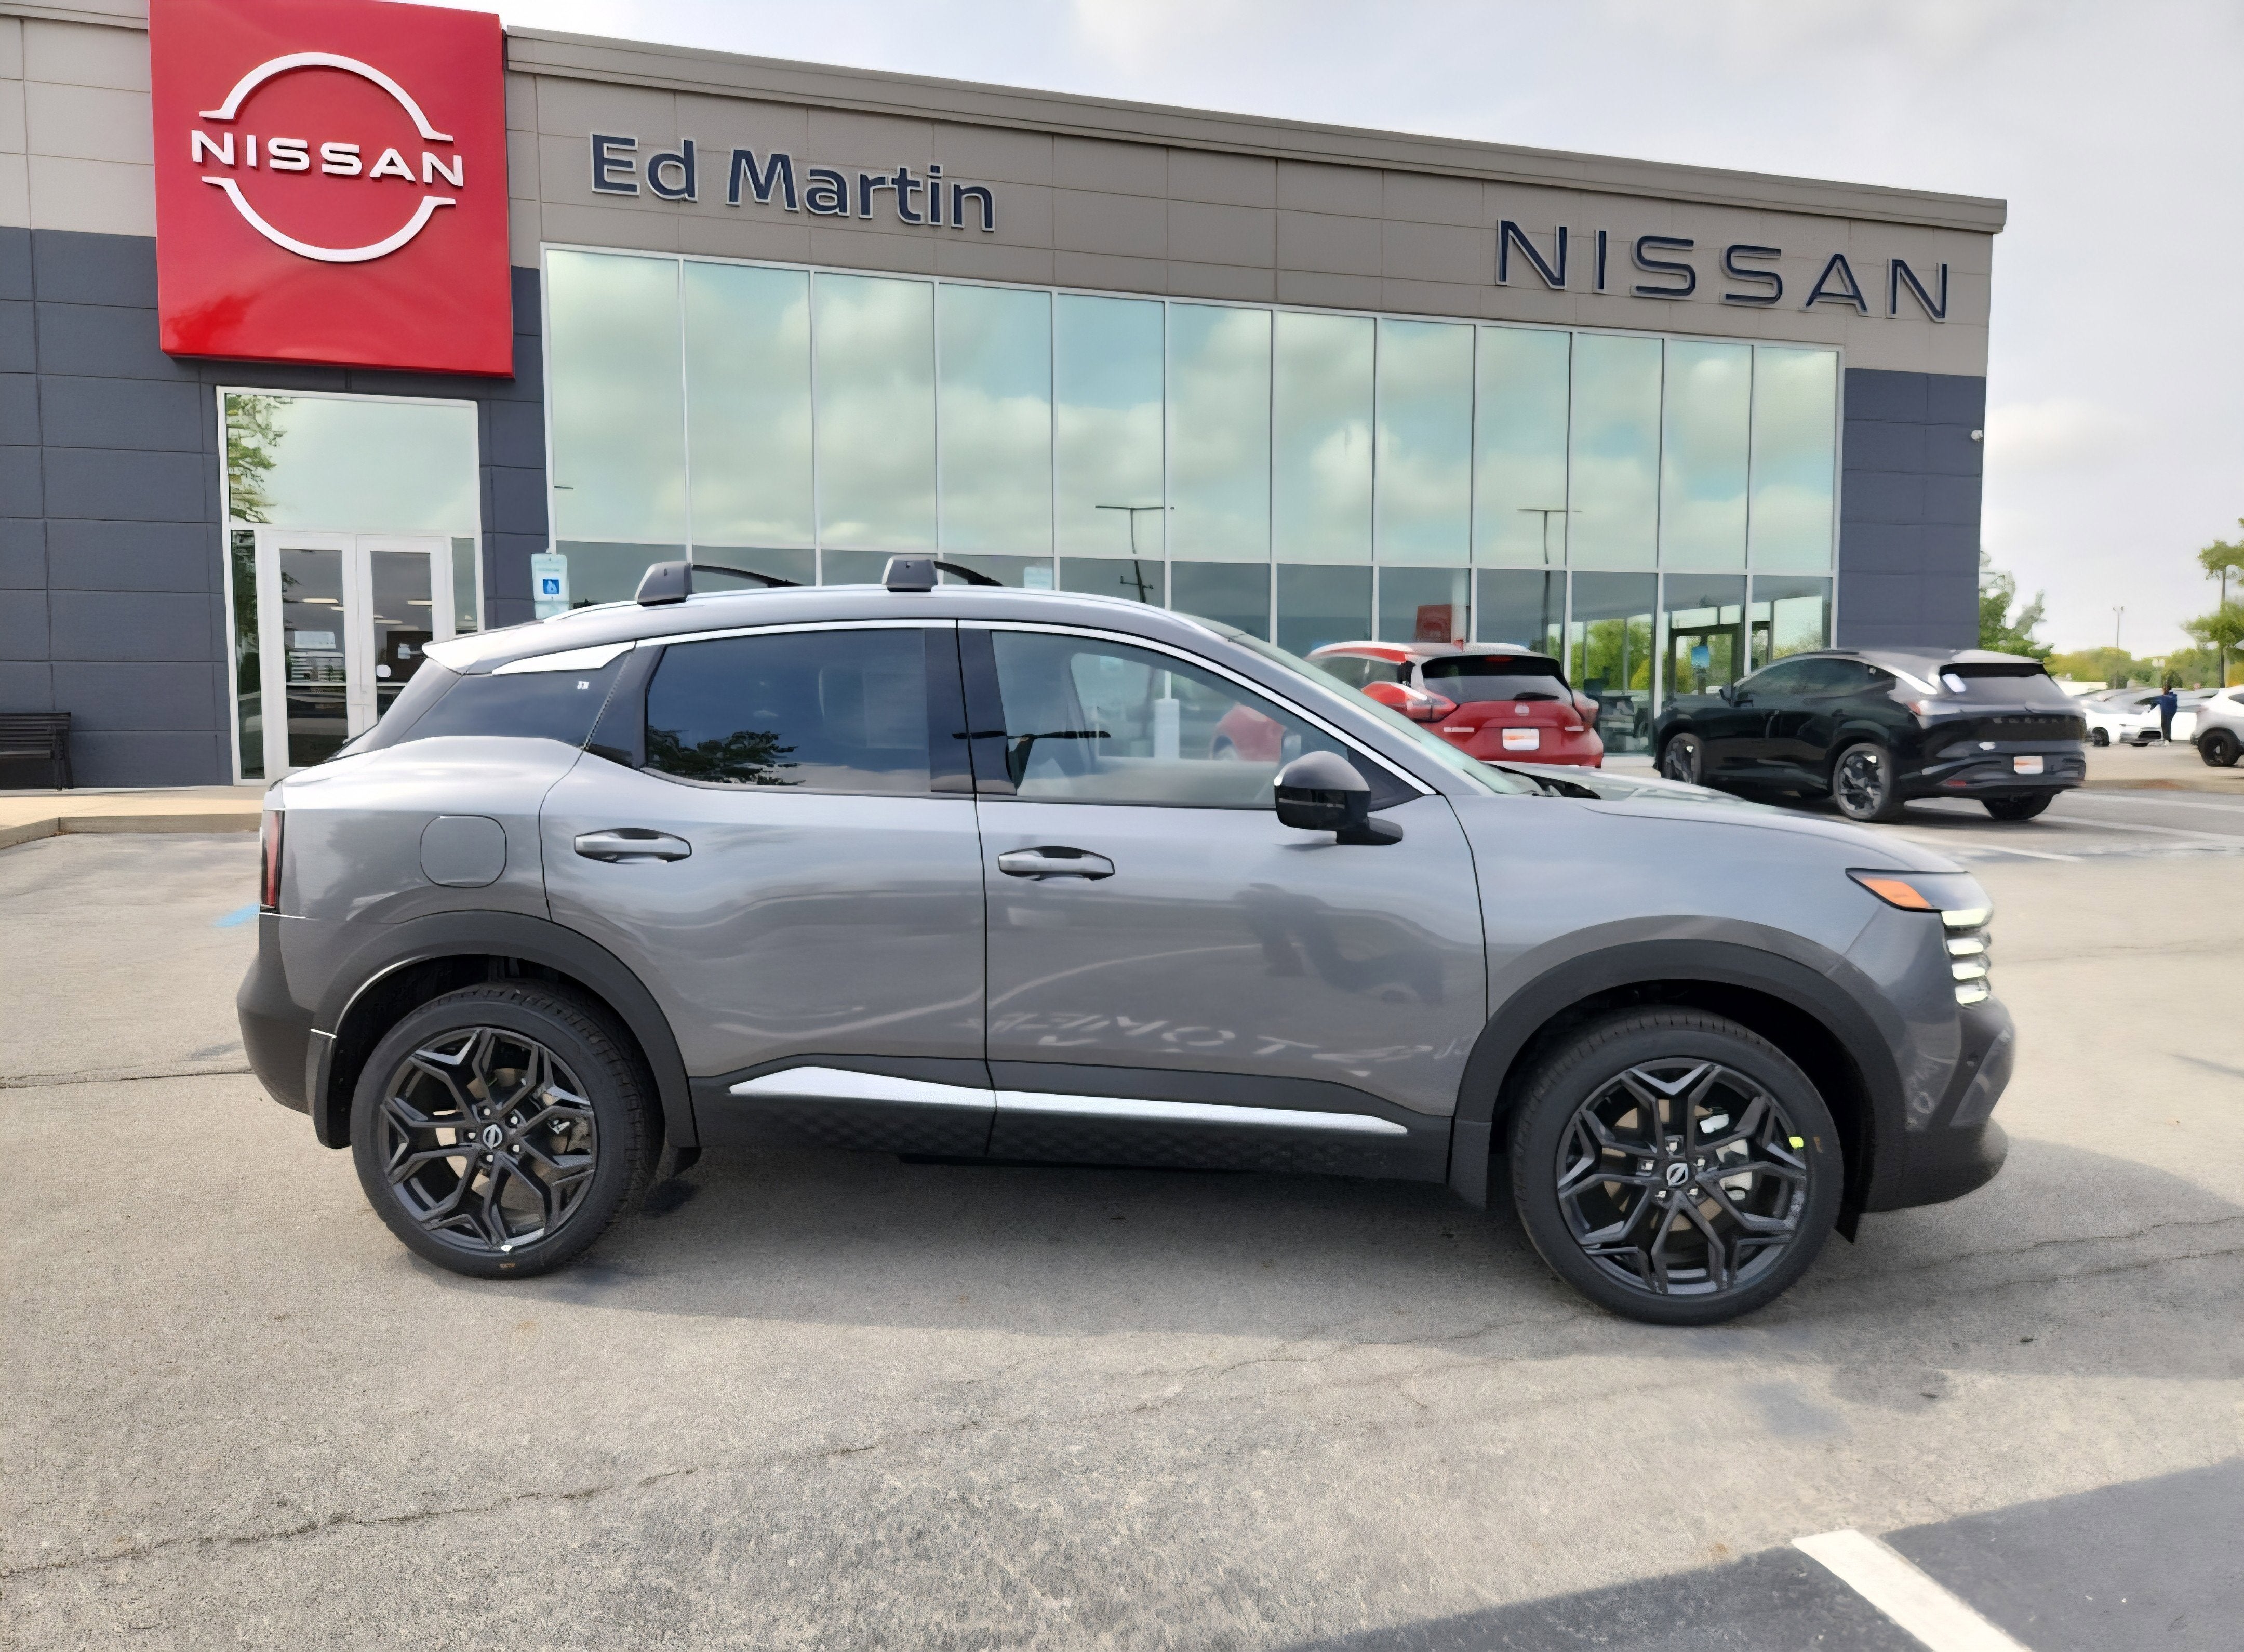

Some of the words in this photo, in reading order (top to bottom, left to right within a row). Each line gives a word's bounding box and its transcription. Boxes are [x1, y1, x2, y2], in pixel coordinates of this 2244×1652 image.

[191, 130, 464, 187] NISSAN
[591, 132, 698, 203] Ed
[726, 149, 995, 232] Martin
[1495, 219, 1950, 324] NISSAN
